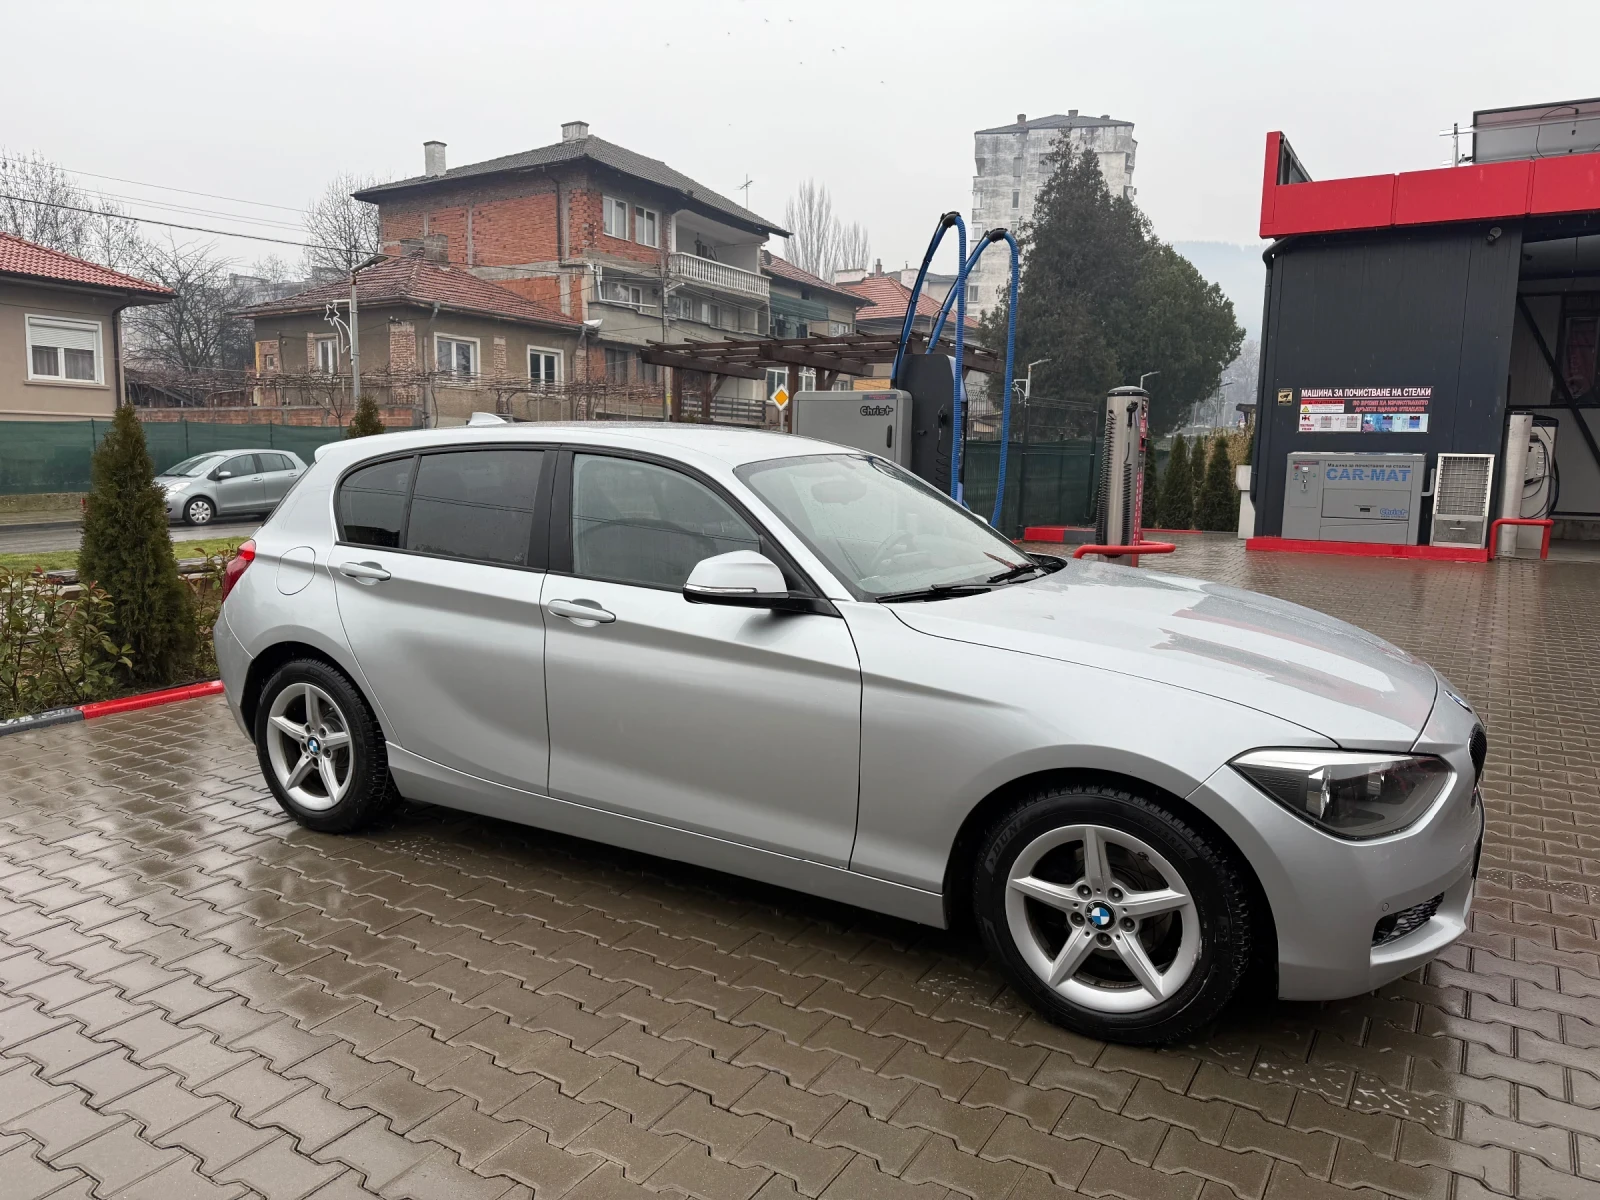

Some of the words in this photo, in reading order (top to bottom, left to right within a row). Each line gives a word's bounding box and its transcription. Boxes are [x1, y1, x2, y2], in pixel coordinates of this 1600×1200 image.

[1301, 389, 1332, 397] МАШИНА
[1334, 389, 1343, 397] ЗА
[1344, 388, 1391, 397] ПОЧИСТВАНЕ
[1392, 388, 1402, 396] НА
[1403, 388, 1431, 396] СТЕЛКИ
[860, 405, 893, 416] Christ
[1326, 468, 1411, 482] CAR-MAT
[1379, 507, 1408, 516] Christ
